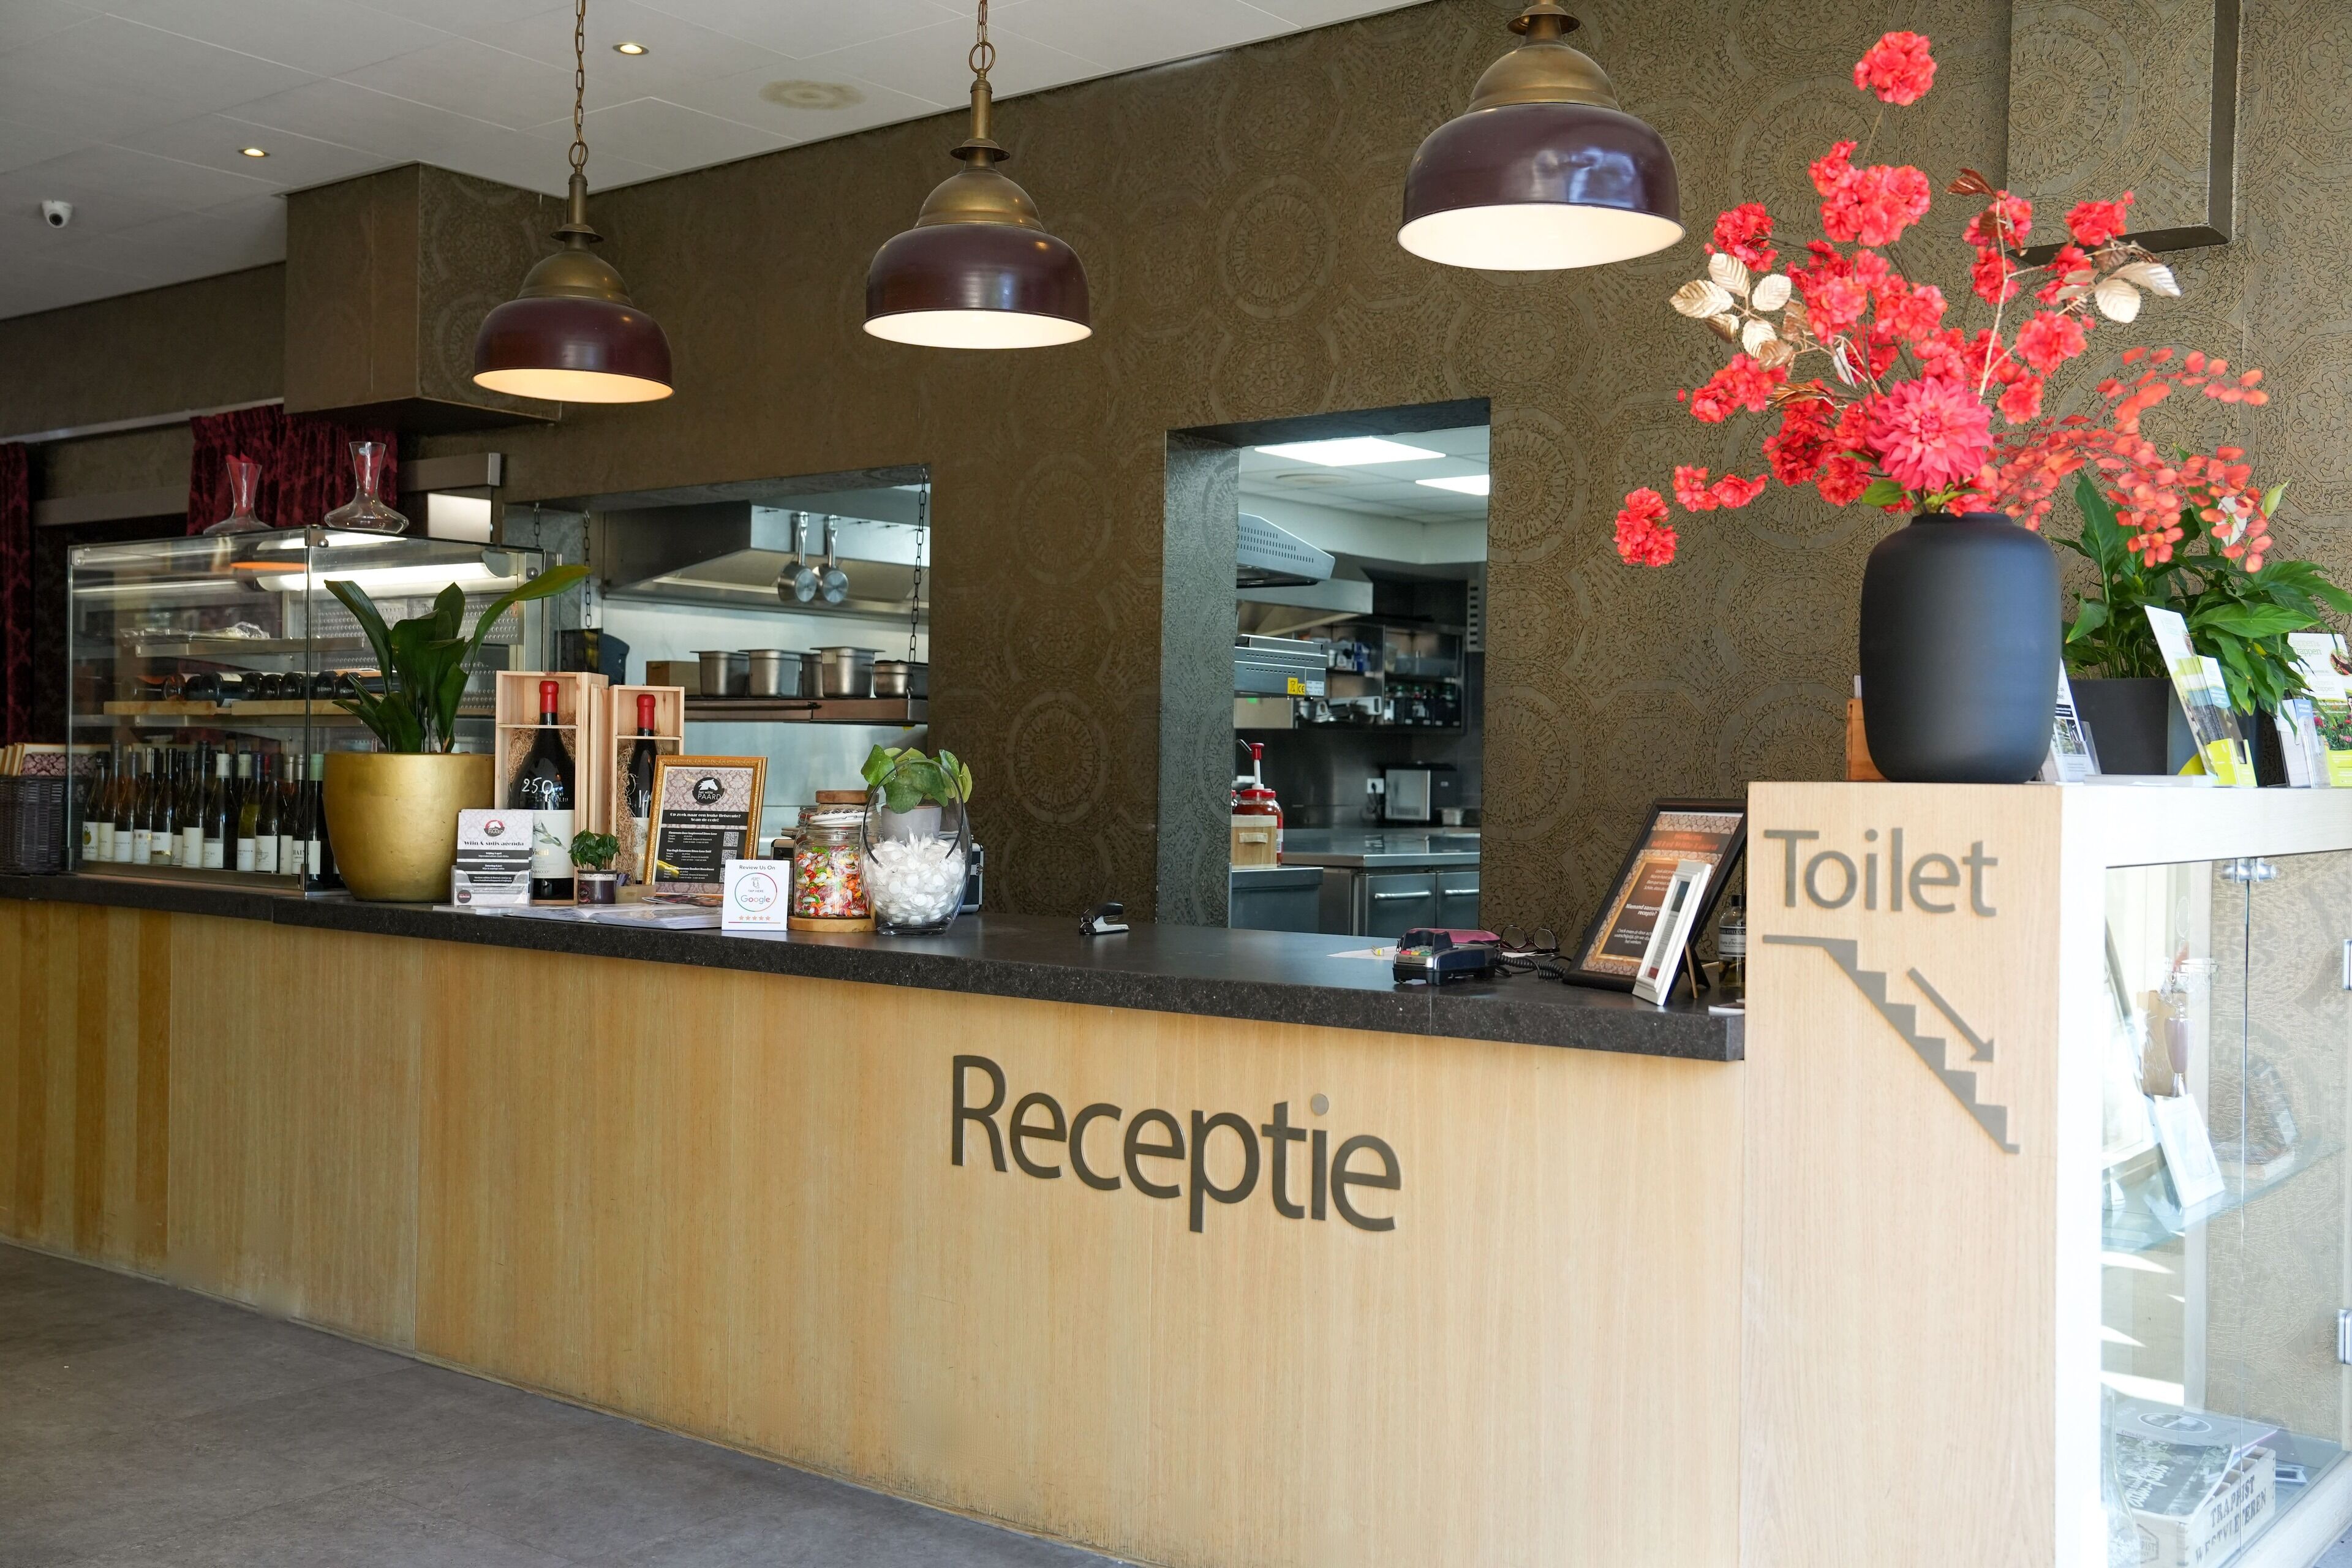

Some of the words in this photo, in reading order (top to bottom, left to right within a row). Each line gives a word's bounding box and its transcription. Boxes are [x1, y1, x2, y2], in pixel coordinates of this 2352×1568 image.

[741, 895, 771, 905] Google
[1764, 827, 1998, 918] Toilet
[952, 1054, 1402, 1233] Receptie
